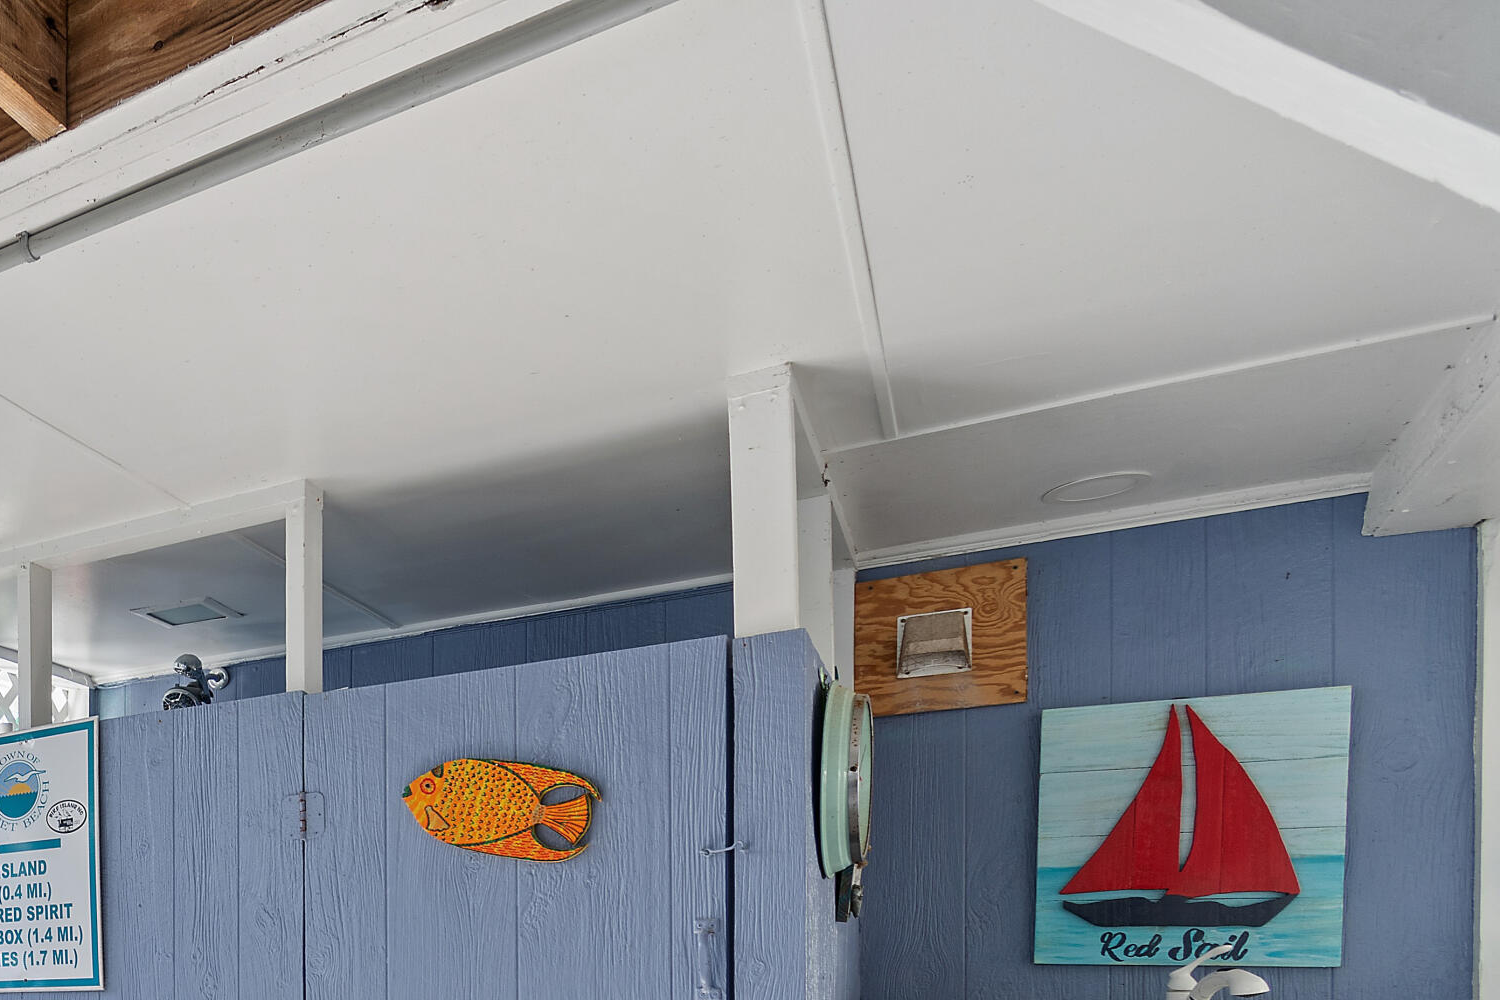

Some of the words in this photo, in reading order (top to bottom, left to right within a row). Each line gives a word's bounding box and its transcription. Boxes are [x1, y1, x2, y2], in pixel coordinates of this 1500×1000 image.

[26, 753, 40, 765] OF
[22, 781, 49, 828] BEACH
[27, 881, 52, 901] MI.)
[27, 903, 73, 922] SPIRIT
[28, 926, 53, 948] (1.4
[57, 925, 84, 945] MI.)
[1099, 931, 1162, 962] Red
[23, 950, 49, 970] (1.7
[53, 949, 78, 969] MI.)
